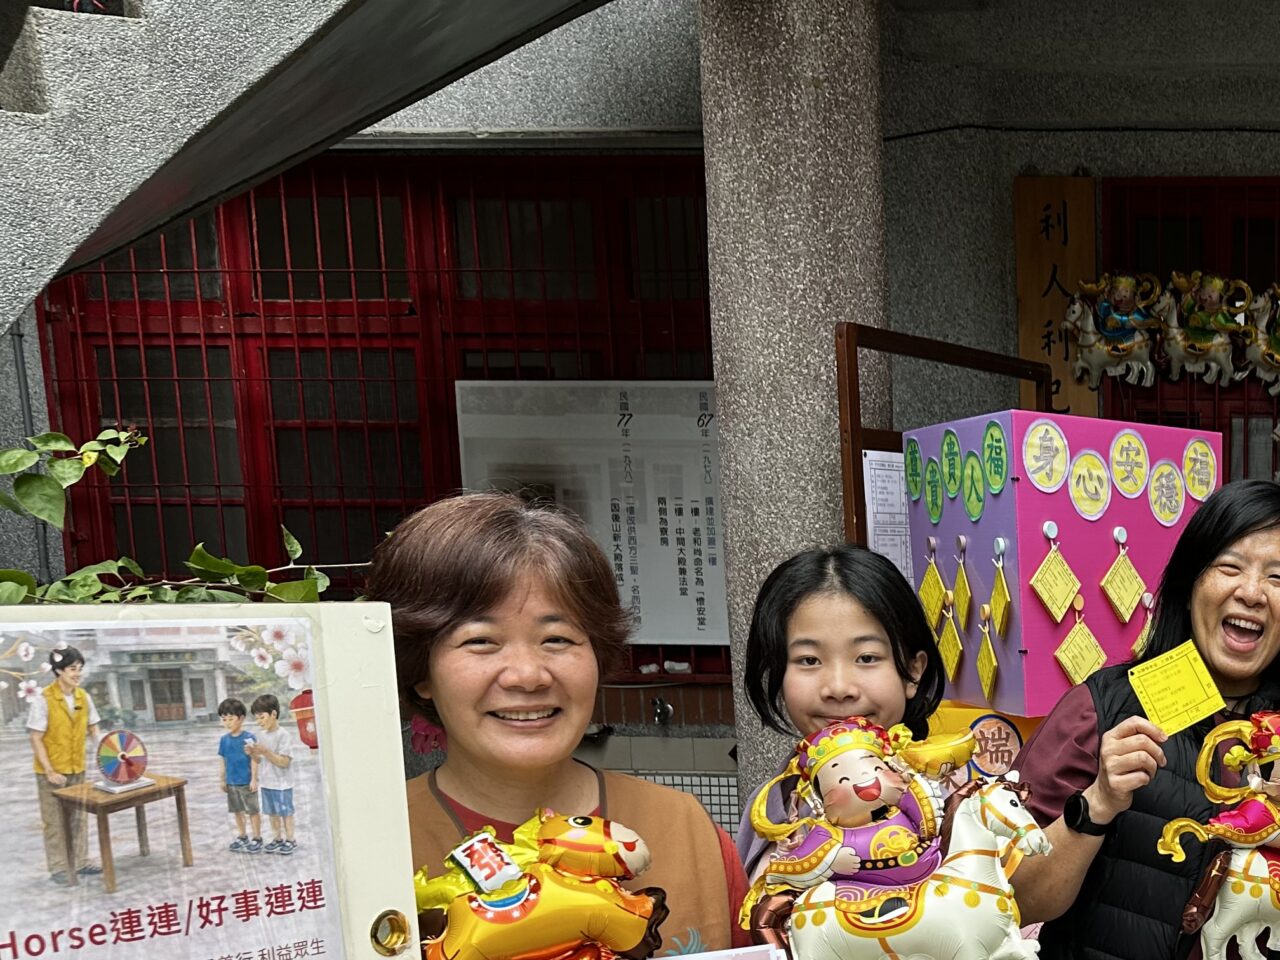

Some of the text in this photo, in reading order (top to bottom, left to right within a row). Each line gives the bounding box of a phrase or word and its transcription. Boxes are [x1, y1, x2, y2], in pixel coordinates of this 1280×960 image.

[975, 726, 1014, 768] 端
[0, 878, 327, 960] Horse連連/好事連連
